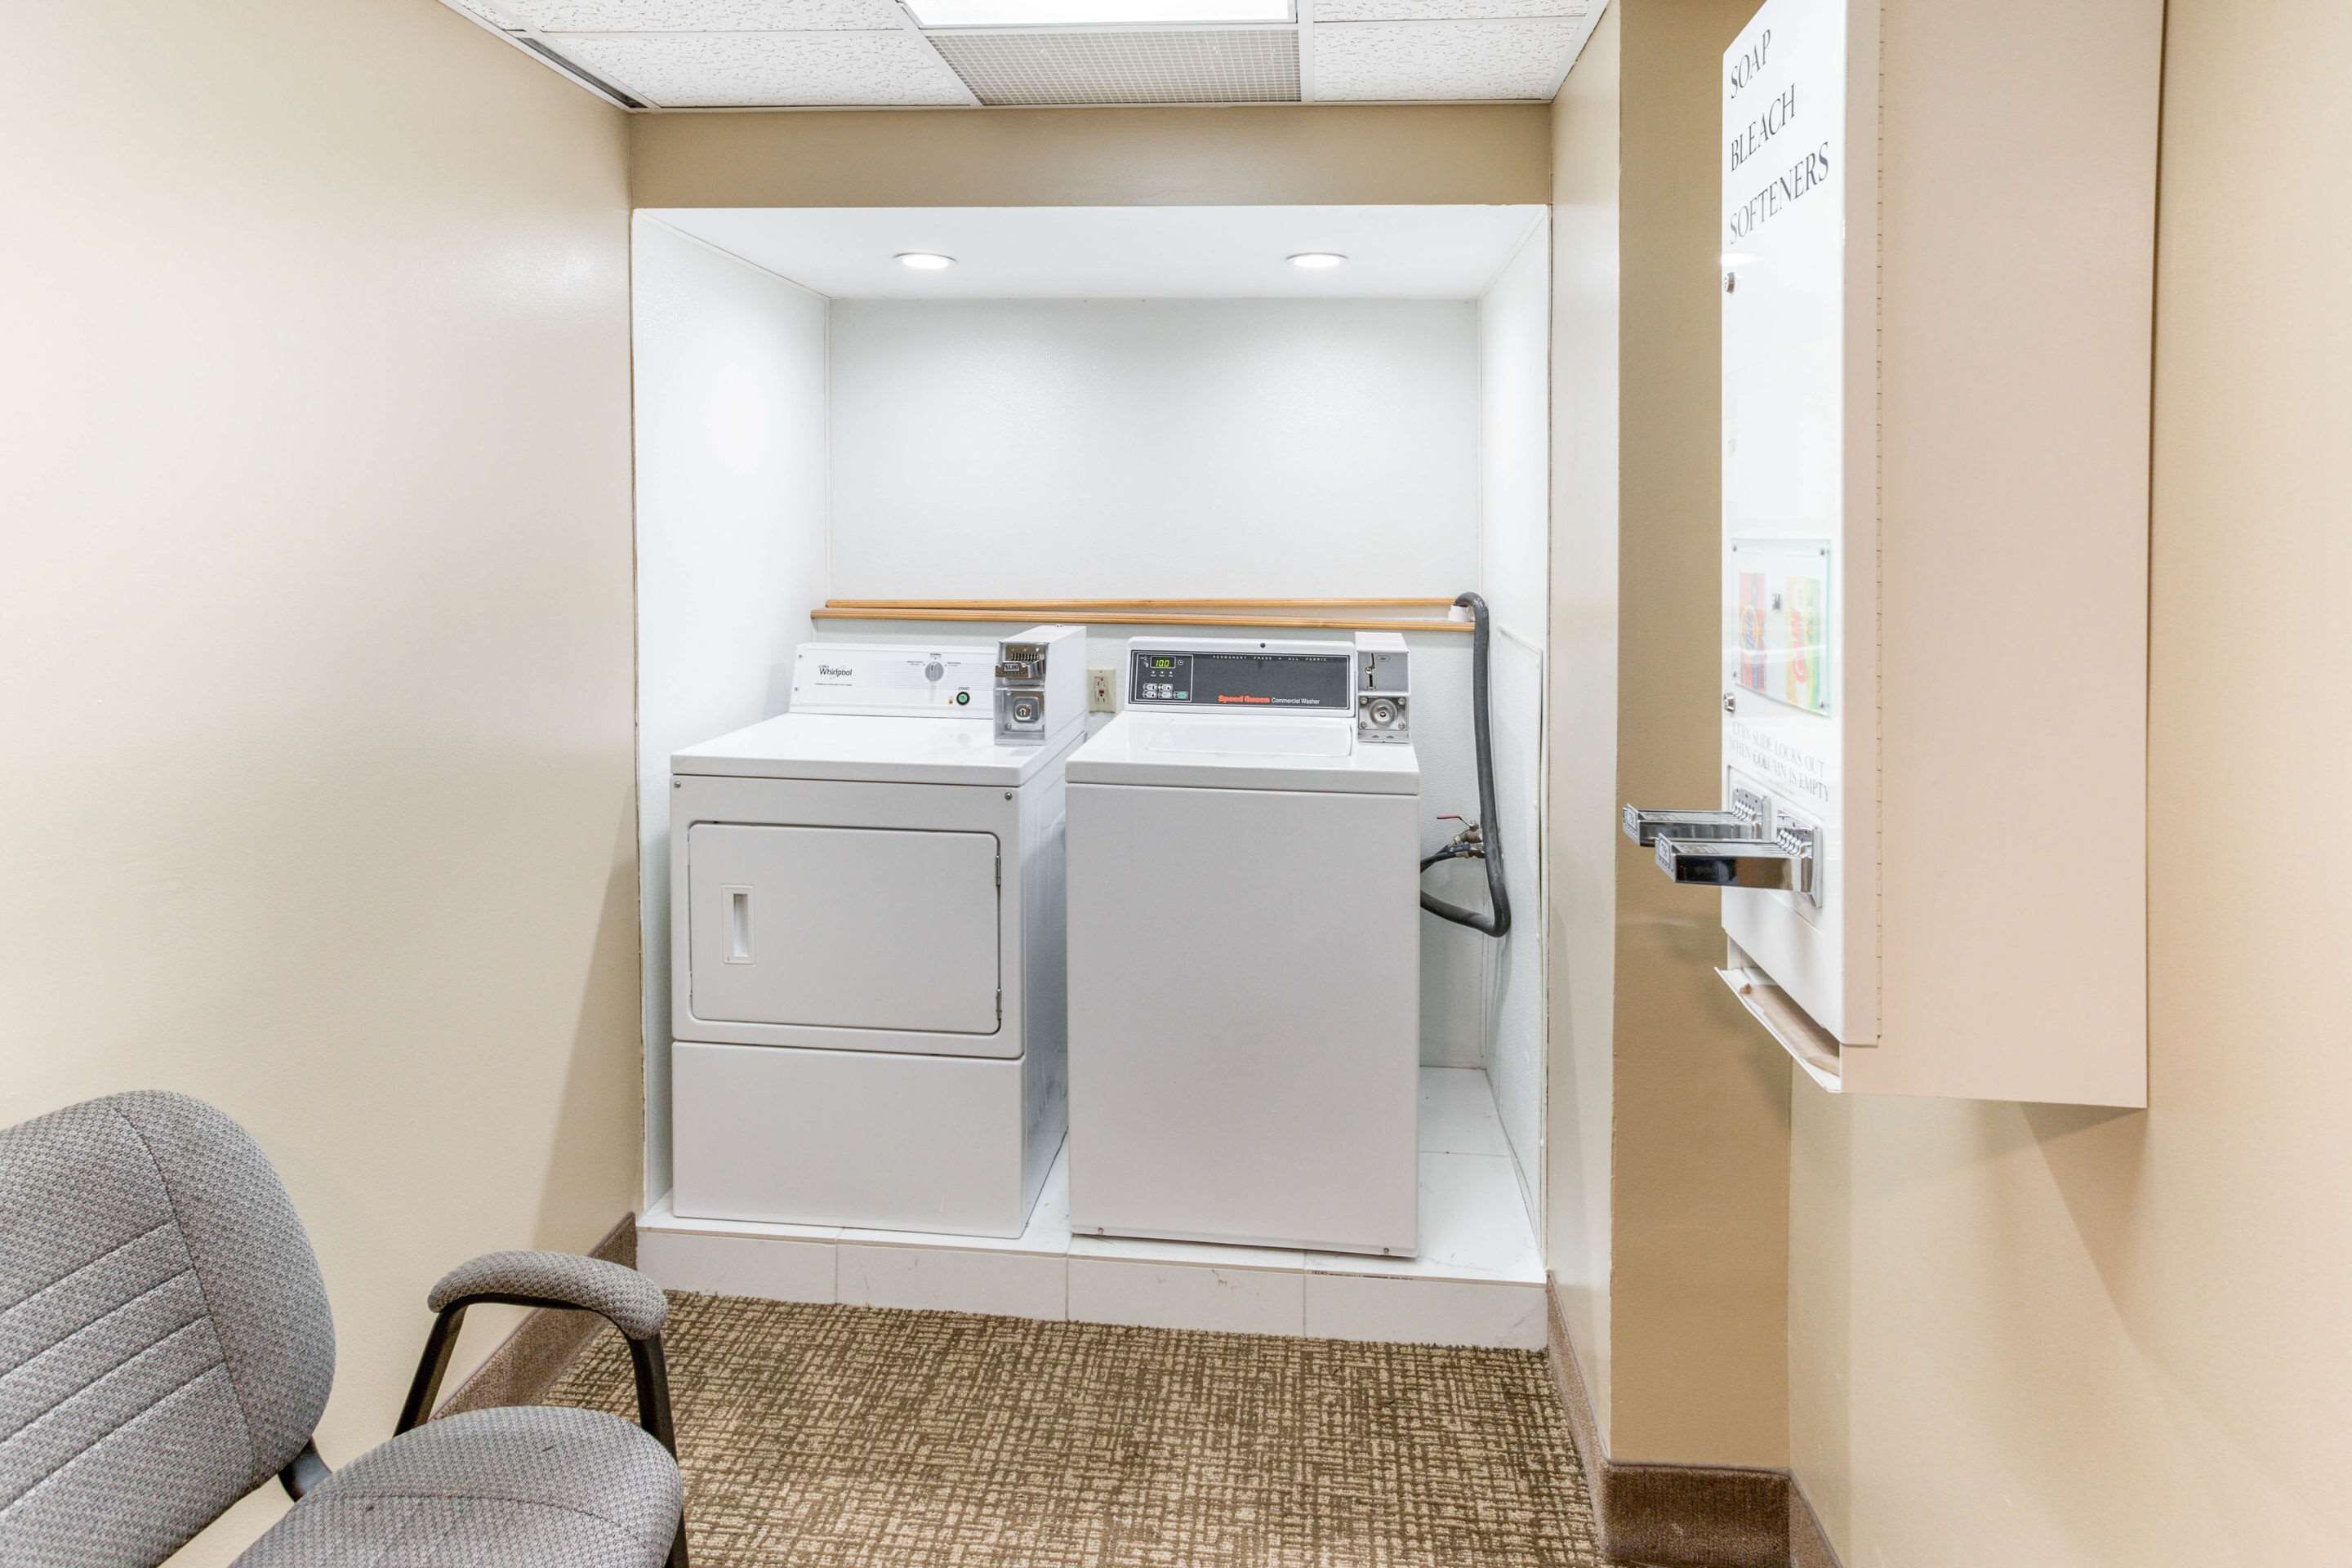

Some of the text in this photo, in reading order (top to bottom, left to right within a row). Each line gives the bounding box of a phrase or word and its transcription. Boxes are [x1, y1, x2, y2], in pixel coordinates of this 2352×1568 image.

[1731, 29, 1771, 100] SOAP
[1731, 82, 1795, 172] BLEACH
[1730, 140, 1829, 245] SOFTENERS
[818, 667, 853, 678] Whirlpool
[1156, 659, 1170, 667] 100
[1218, 695, 1244, 703] Speed
[1798, 773, 1829, 803] EMPTY
